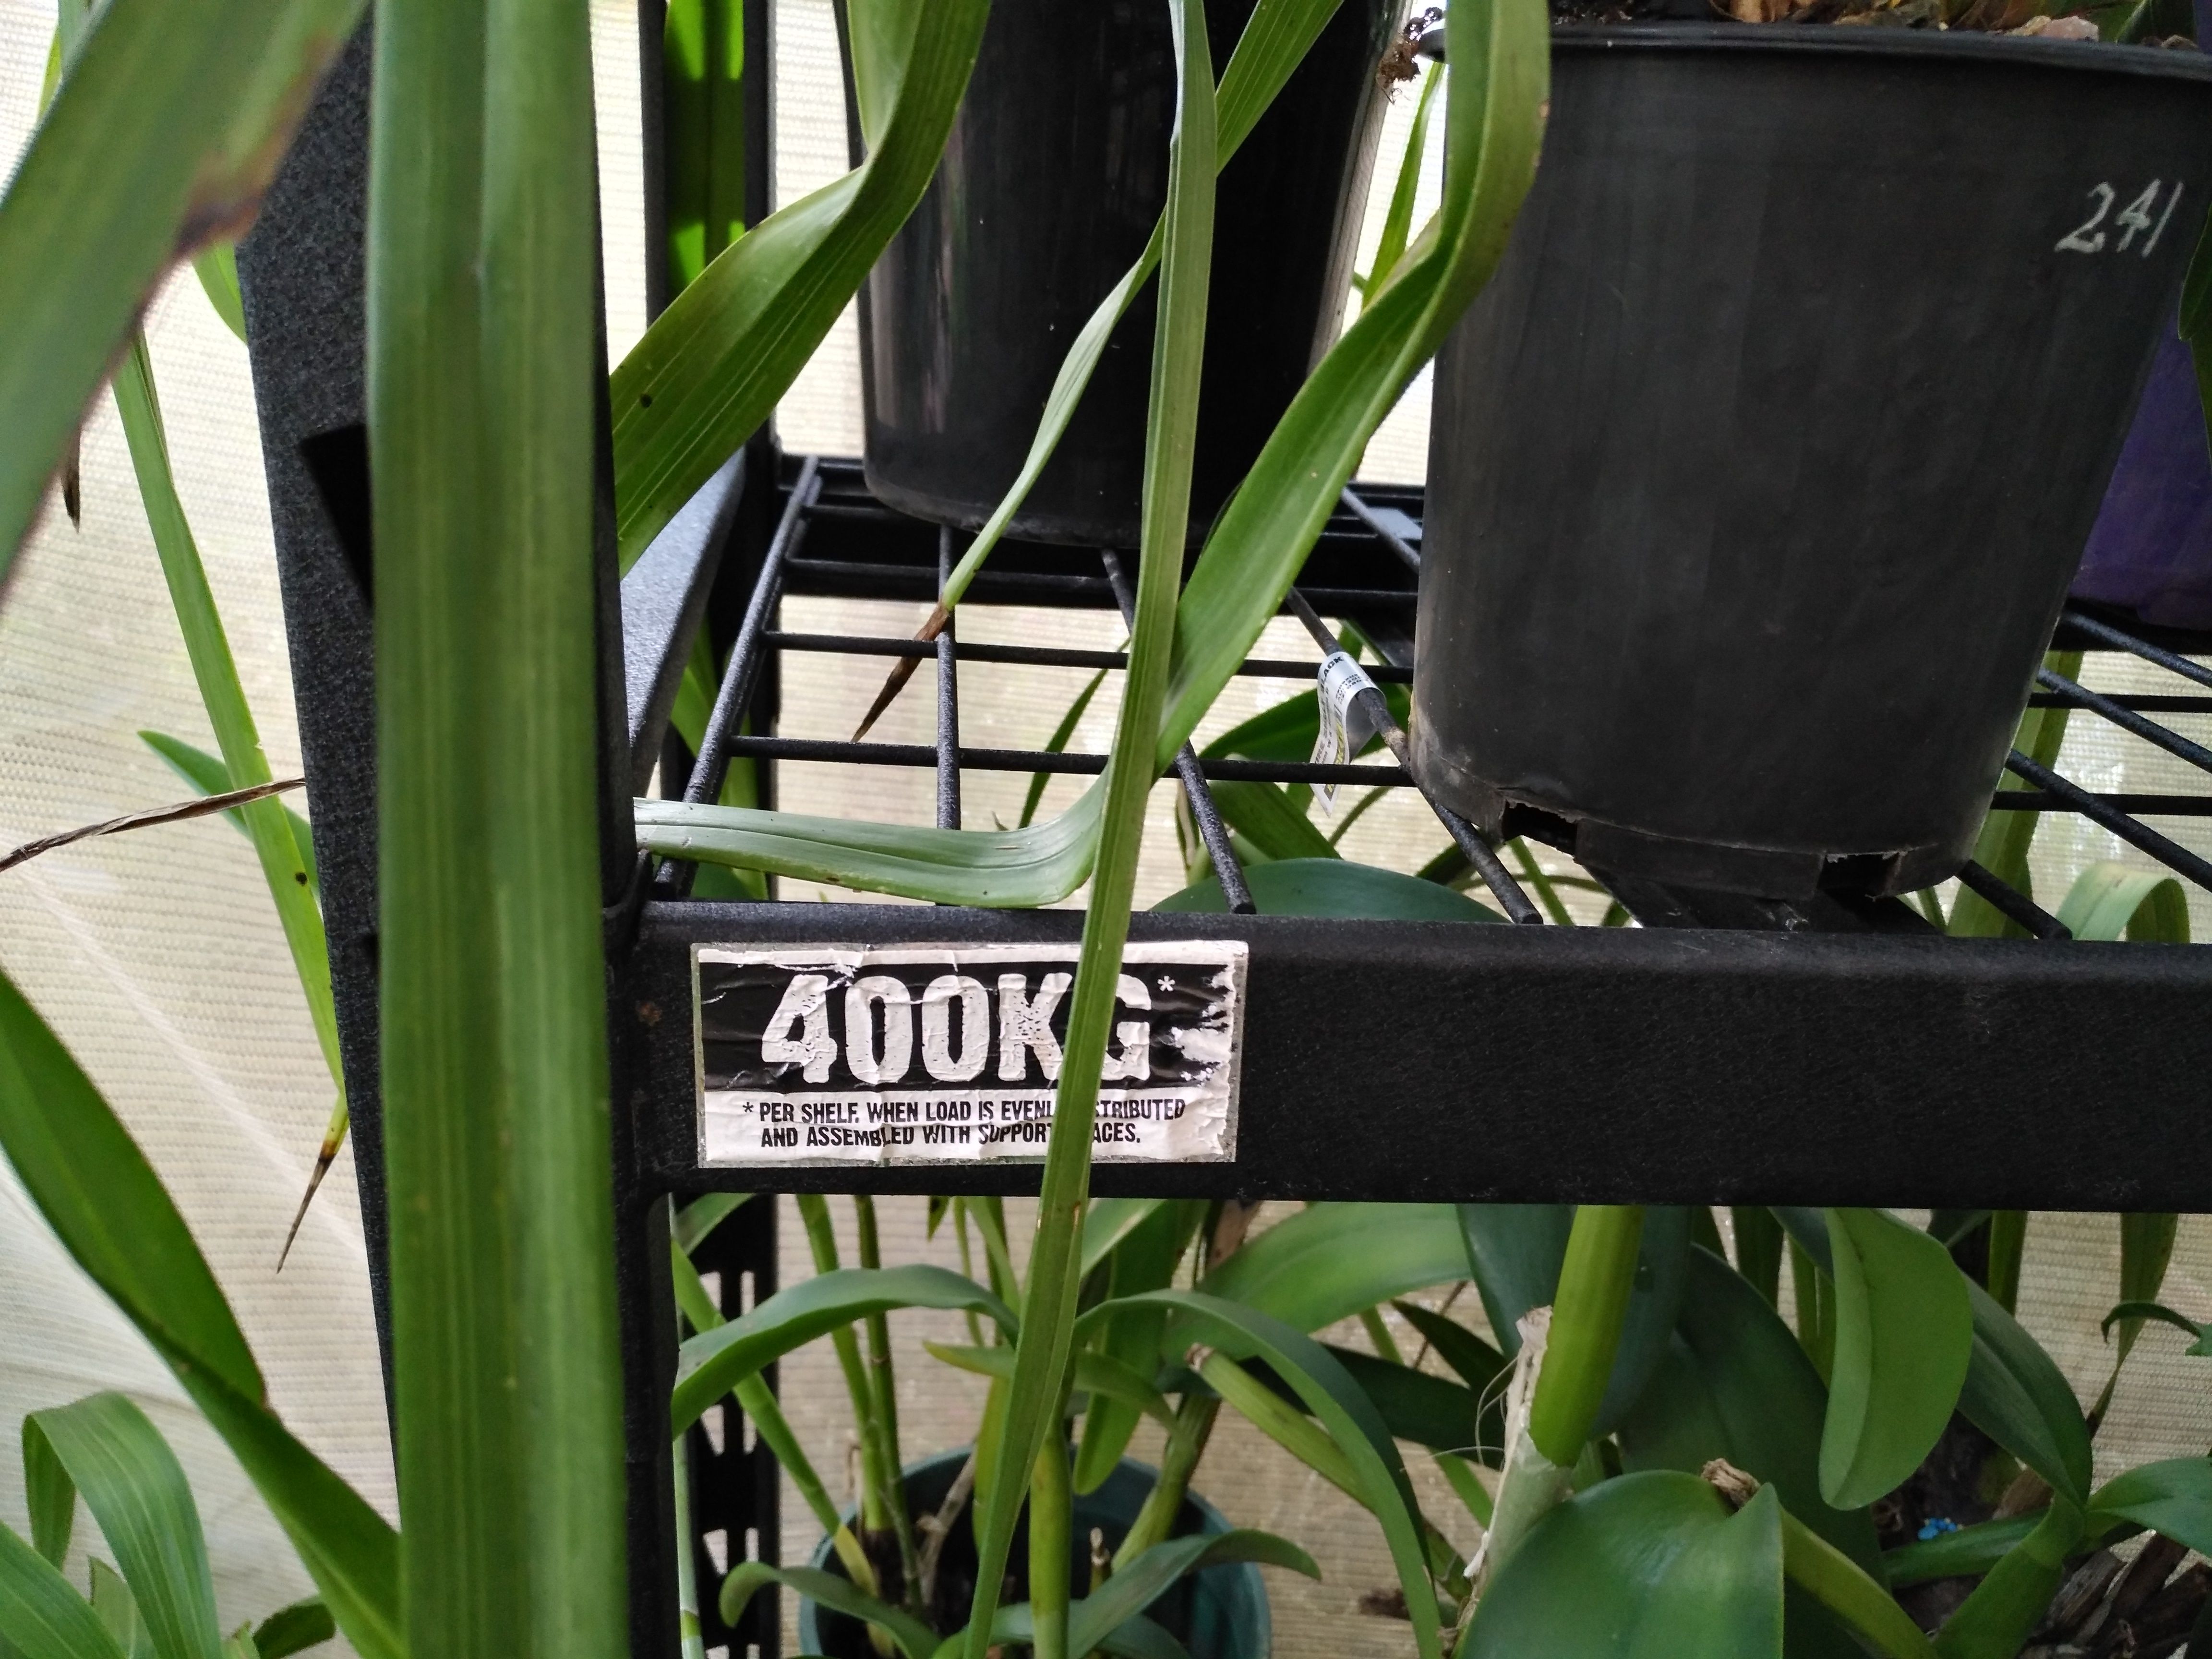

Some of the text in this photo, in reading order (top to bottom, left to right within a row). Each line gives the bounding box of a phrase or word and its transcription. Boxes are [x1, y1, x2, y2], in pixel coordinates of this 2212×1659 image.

[2054, 178, 2185, 257] 241
[866, 1102, 918, 1123] WHEN
[926, 1101, 971, 1121] LOAD
[978, 1101, 994, 1121] IS
[1001, 1100, 1053, 1121] EVENL
[1095, 1099, 1186, 1120] TRIBUTED
[761, 1127, 798, 1147] AND
[806, 1126, 914, 1147] ASSEMBLED
[922, 1124, 971, 1144] WITH
[1093, 1122, 1141, 1143] ACES.
